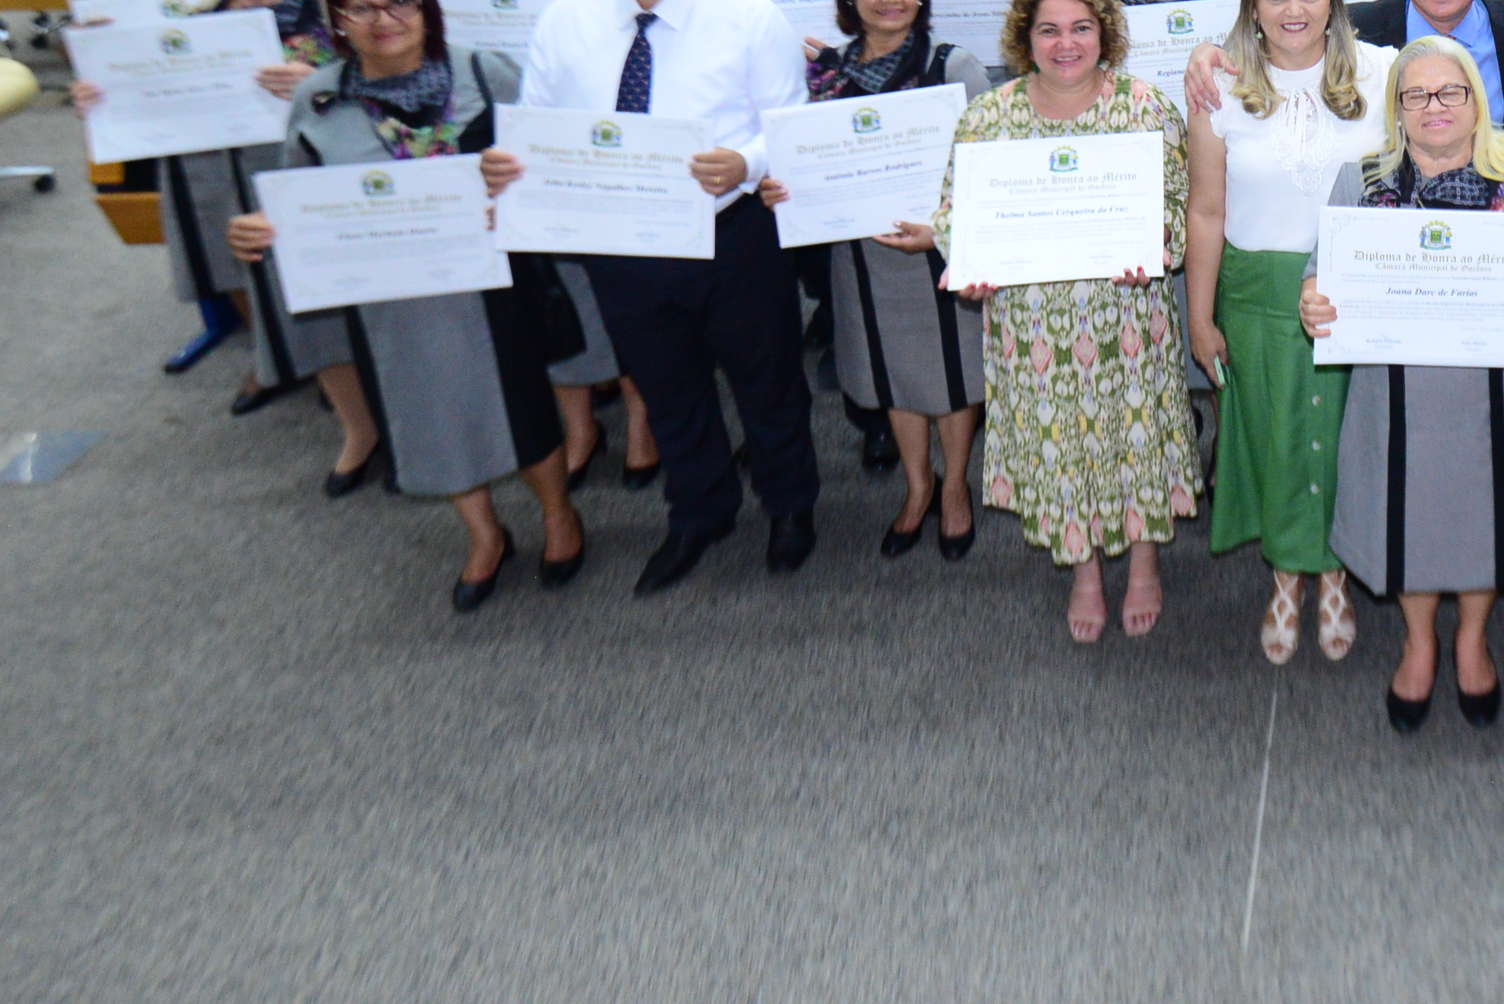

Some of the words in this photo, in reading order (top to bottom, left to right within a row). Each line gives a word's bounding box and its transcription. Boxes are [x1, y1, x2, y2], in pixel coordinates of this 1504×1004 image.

[796, 142, 840, 154] Diploma
[842, 140, 853, 148] de
[856, 135, 890, 145] Honra
[907, 126, 940, 136] Mérito
[989, 177, 1033, 188] Diploma
[1036, 177, 1046, 186] de
[1051, 174, 1084, 185] Honra
[1086, 174, 1099, 183] ao
[1102, 172, 1137, 183] Mérito
[995, 211, 1025, 219] Thelma
[1055, 207, 1095, 217] Cerqueira
[1354, 250, 1401, 262] Diploma
[1406, 252, 1417, 262] de
[1422, 251, 1456, 263] Honra
[1461, 254, 1473, 264] ao
[1385, 287, 1413, 296] Joana
[1414, 288, 1436, 296] Darc
[1437, 288, 1449, 297] de
[1450, 288, 1479, 297] Farias
